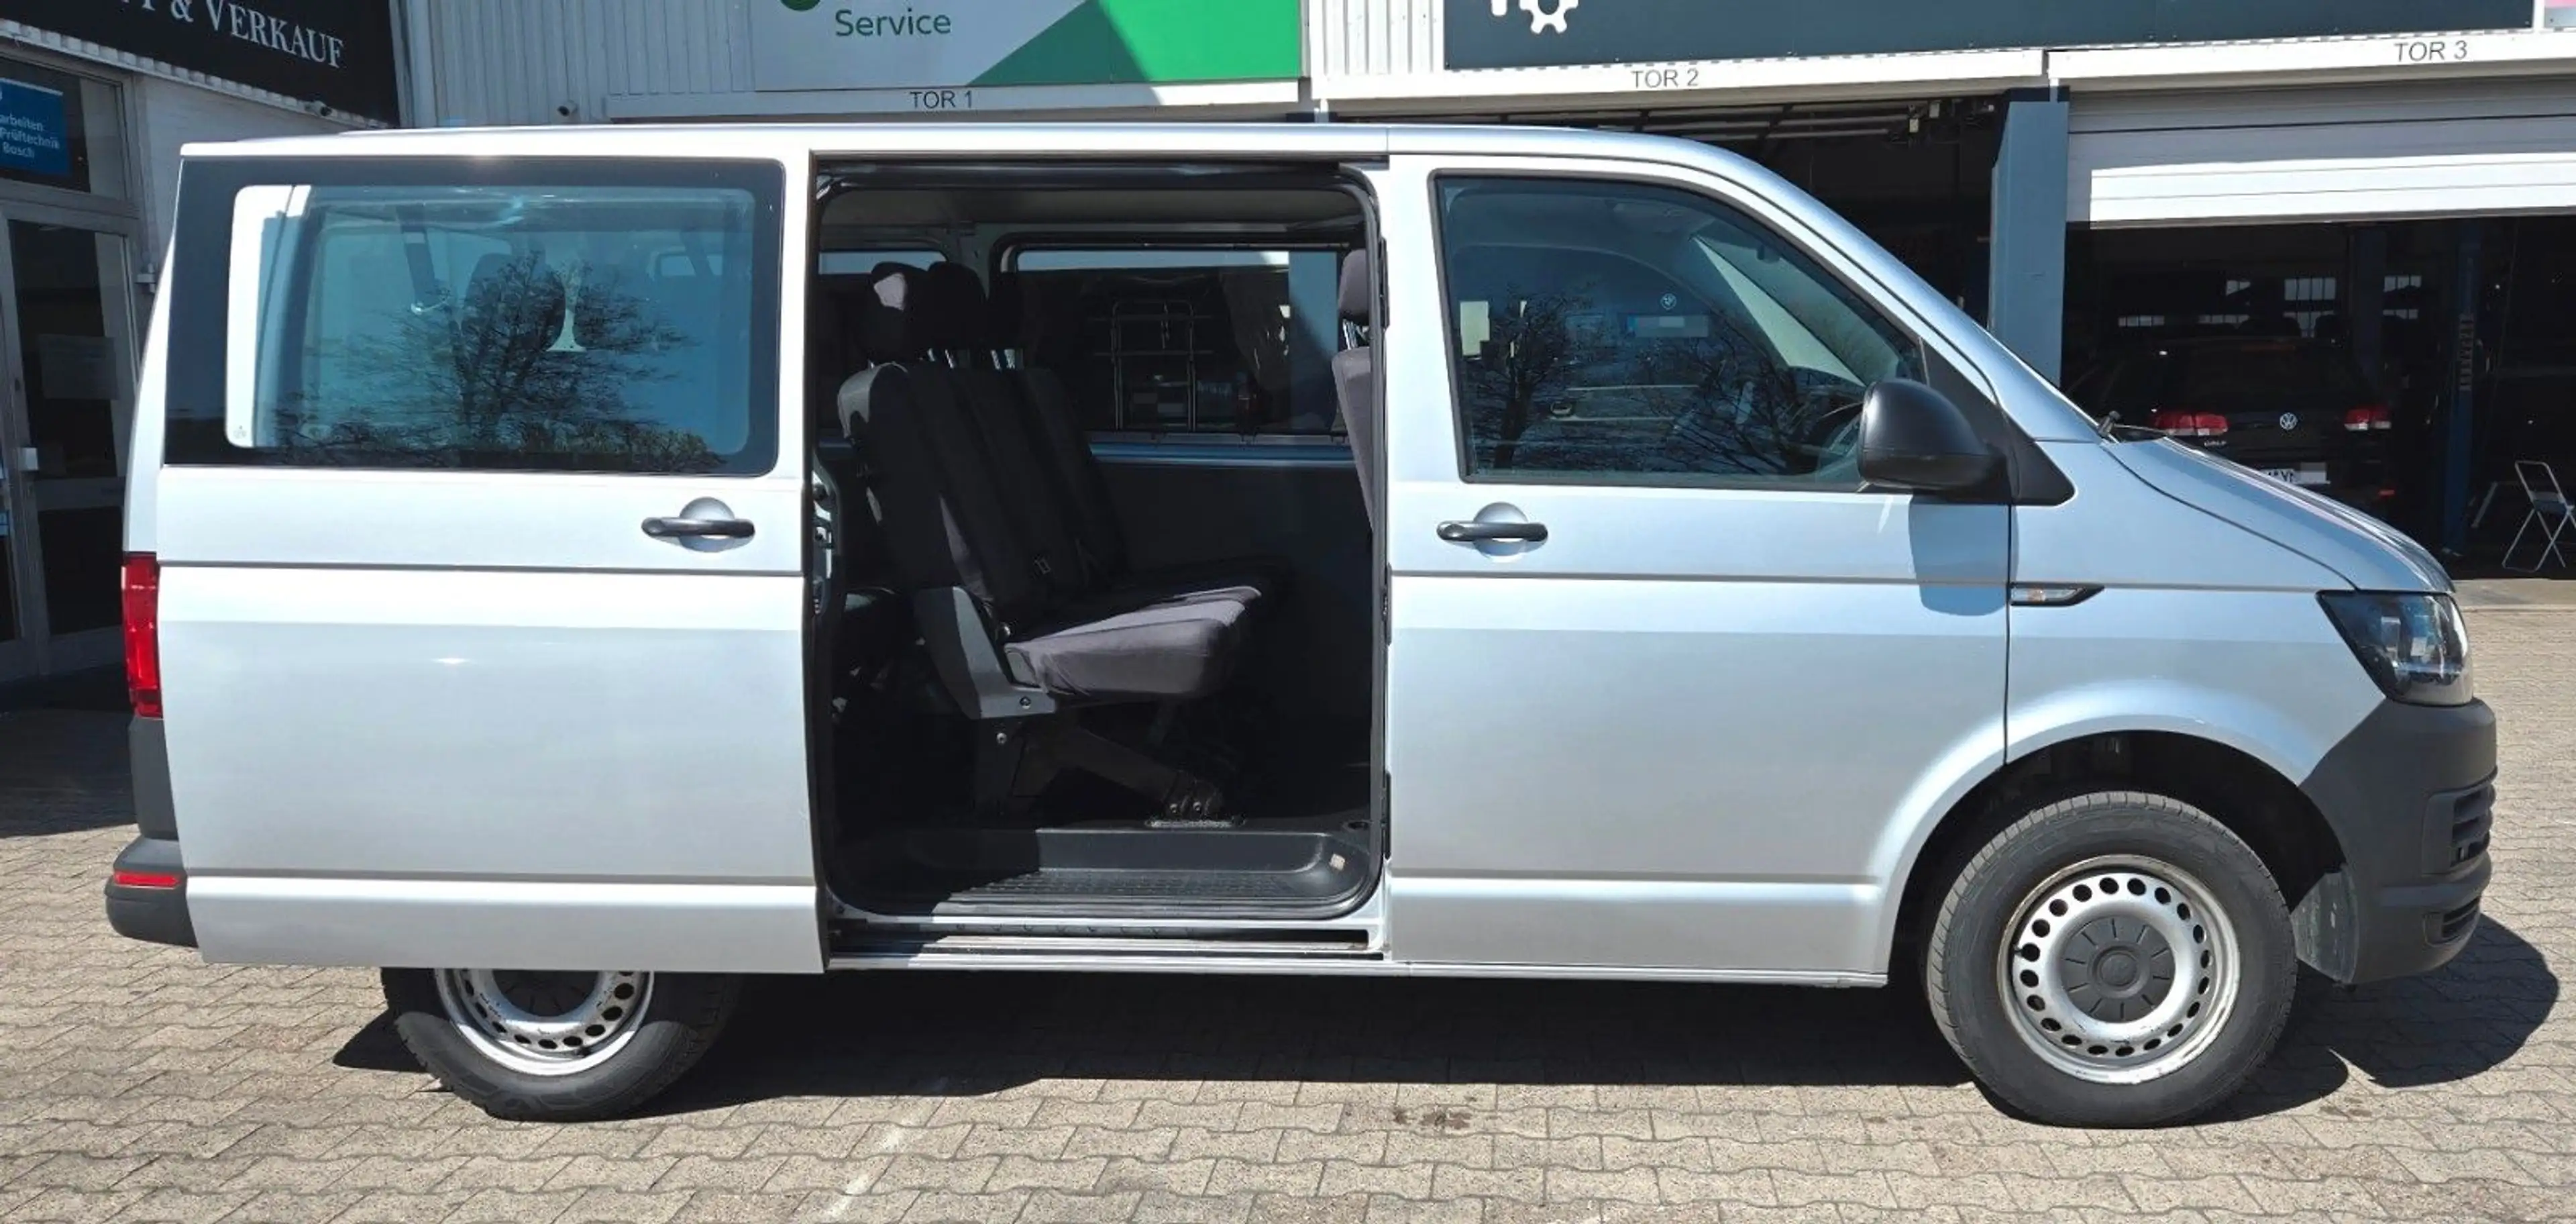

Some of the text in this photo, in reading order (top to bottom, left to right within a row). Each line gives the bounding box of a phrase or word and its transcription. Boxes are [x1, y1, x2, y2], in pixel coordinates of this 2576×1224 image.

[836, 8, 951, 36] Service
[207, 0, 343, 68] VERKAUF
[2394, 40, 2467, 62] TOR 3
[1631, 68, 1699, 89] TOR 2
[910, 91, 973, 109] TOR 1
[3, 141, 35, 158] Bosch
